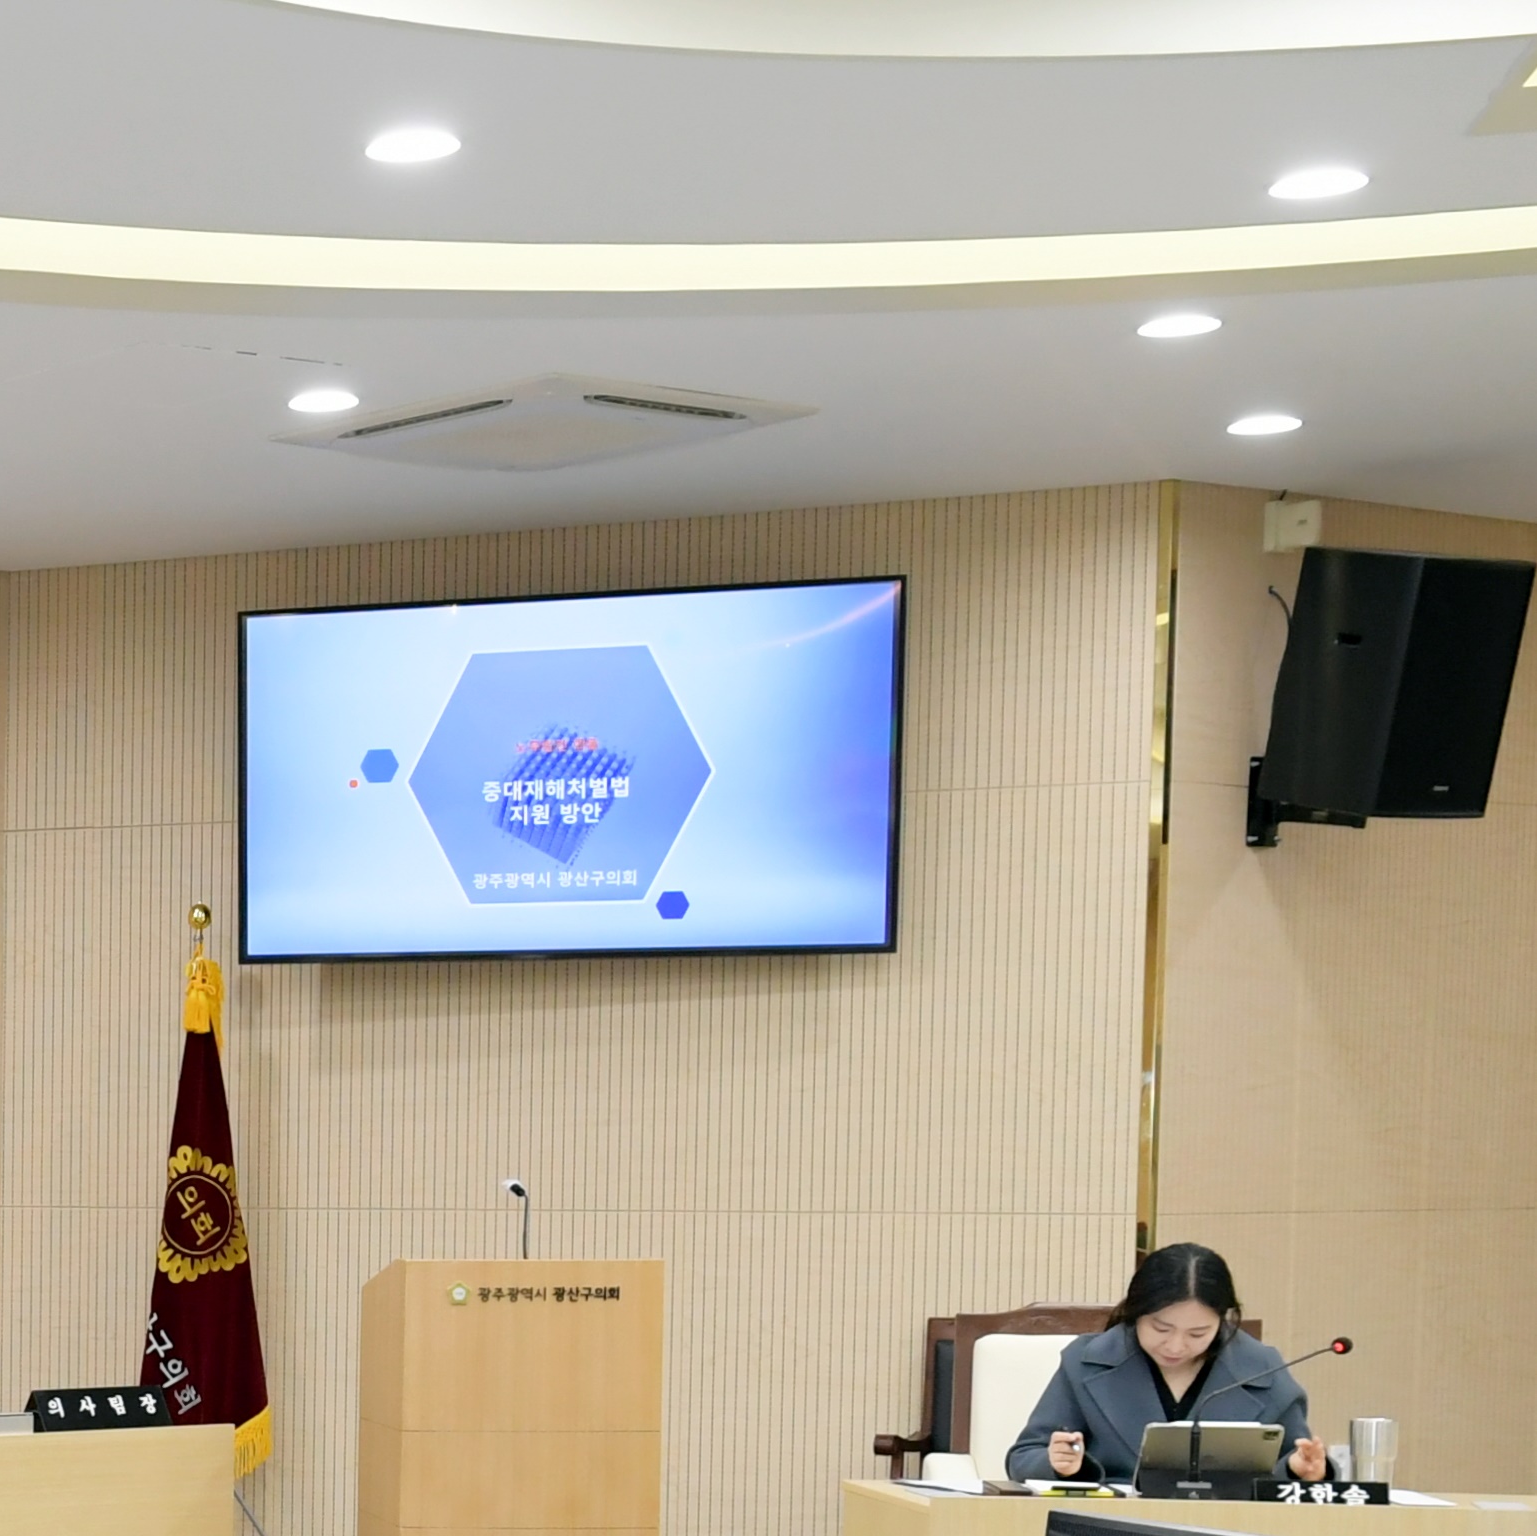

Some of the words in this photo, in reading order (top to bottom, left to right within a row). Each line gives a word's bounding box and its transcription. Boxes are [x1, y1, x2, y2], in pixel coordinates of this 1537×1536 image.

[482, 776, 630, 803] 중대재해처벌법
[509, 803, 550, 826] 지원
[559, 802, 603, 825] 방안
[472, 871, 551, 889] 광주광역시
[557, 869, 638, 888] 광산구의회
[176, 1186, 221, 1246] 의회
[477, 1287, 547, 1303] 광주광역시
[552, 1286, 621, 1303] 광산구의회
[1276, 1481, 1371, 1505] 강한솔
